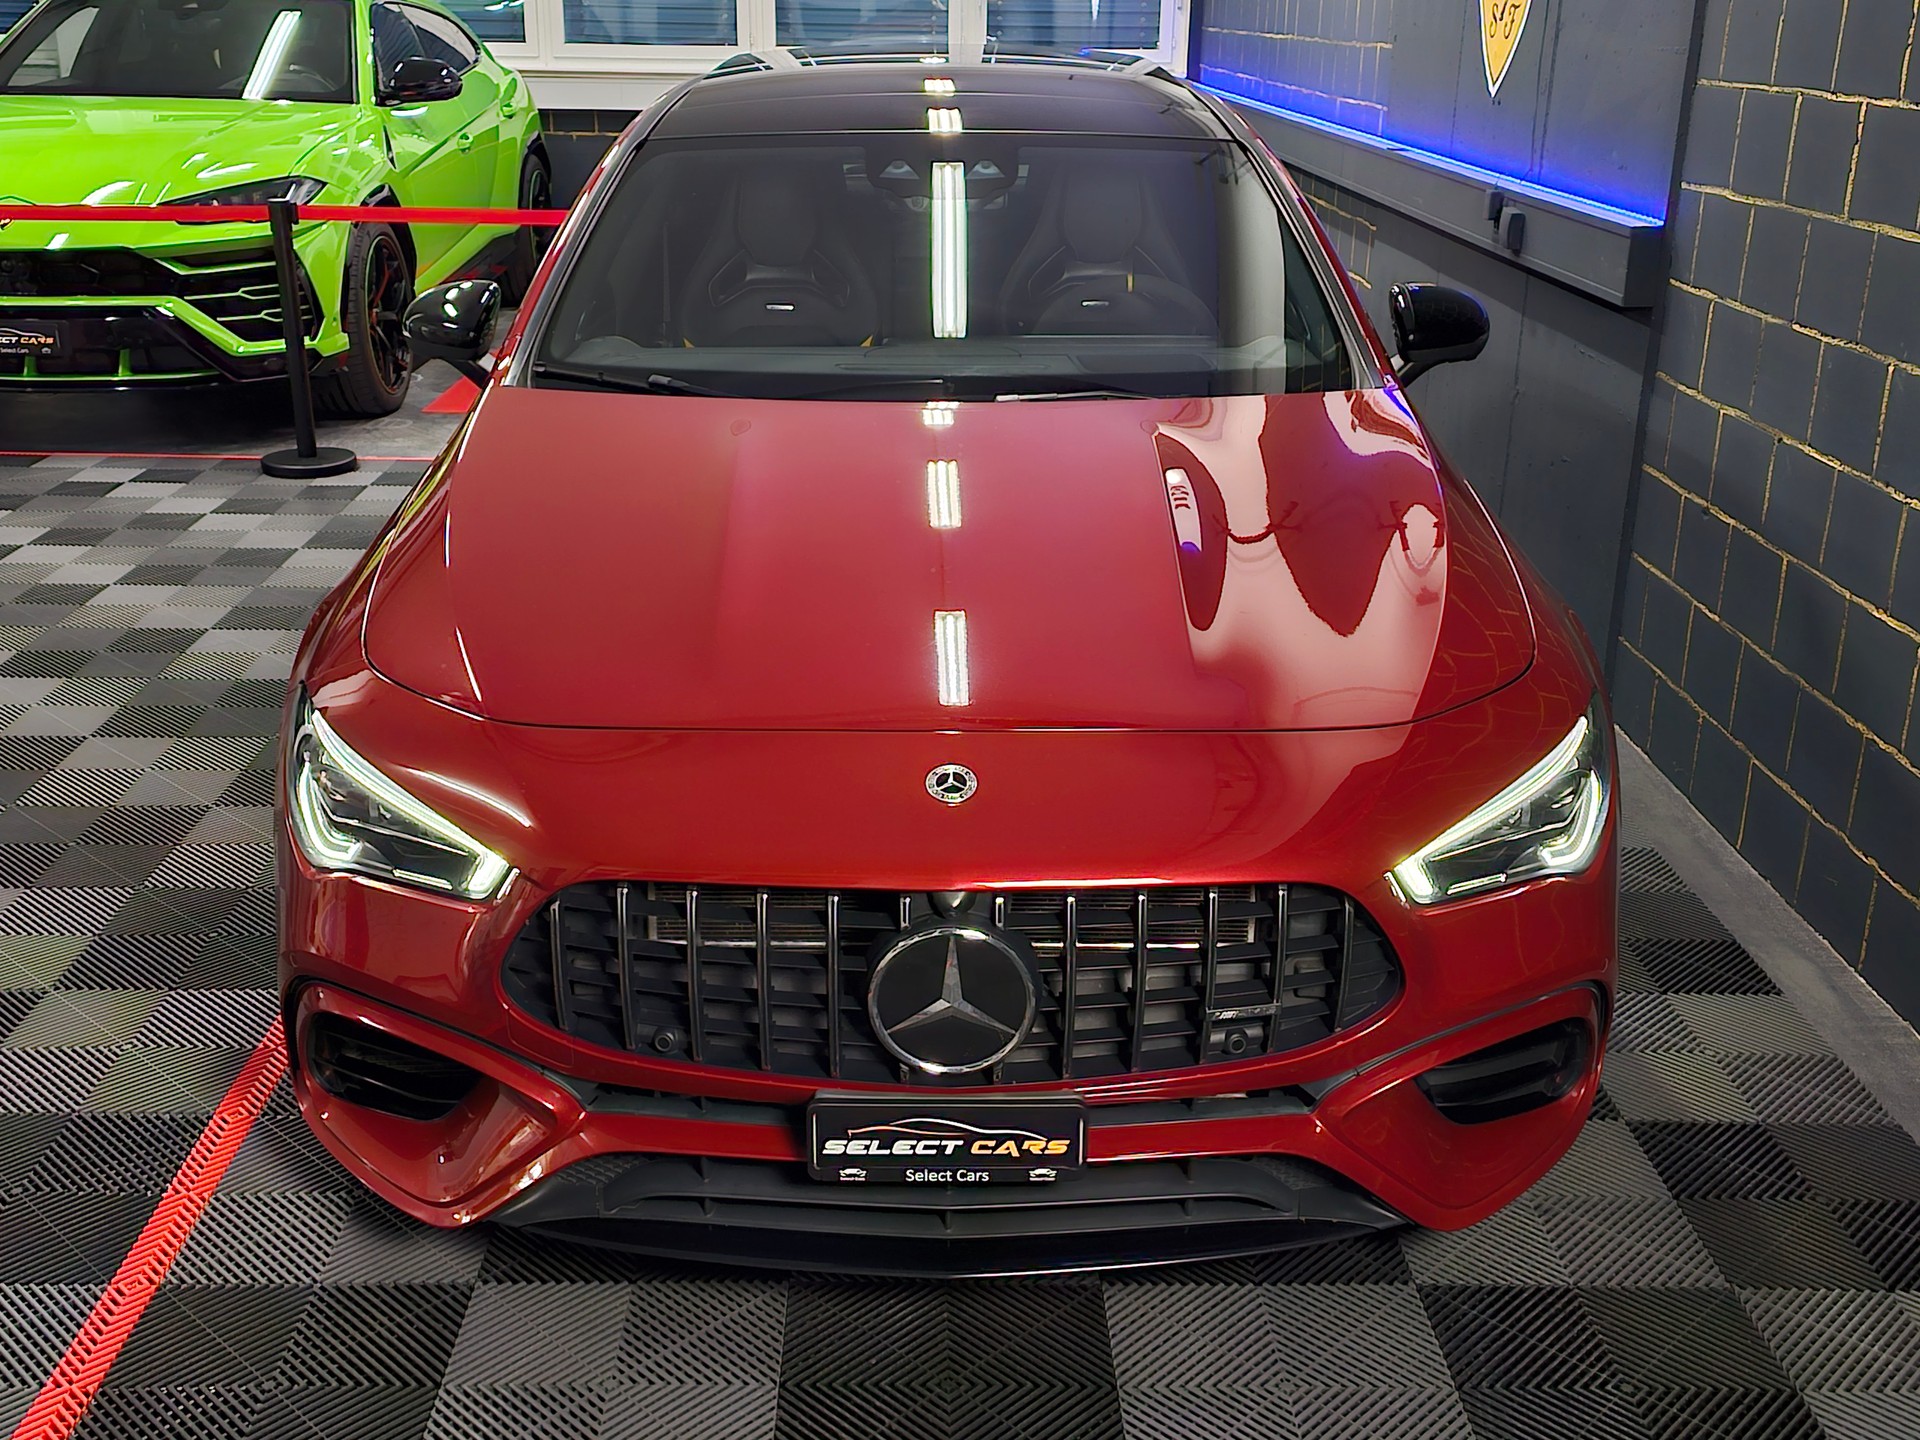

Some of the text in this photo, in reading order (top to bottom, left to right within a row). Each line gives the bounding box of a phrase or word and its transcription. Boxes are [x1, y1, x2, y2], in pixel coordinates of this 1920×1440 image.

[20, 336, 54, 345] CARS
[822, 1139, 1071, 1157] SELECT CARS
[905, 1169, 990, 1182] Select Cars
